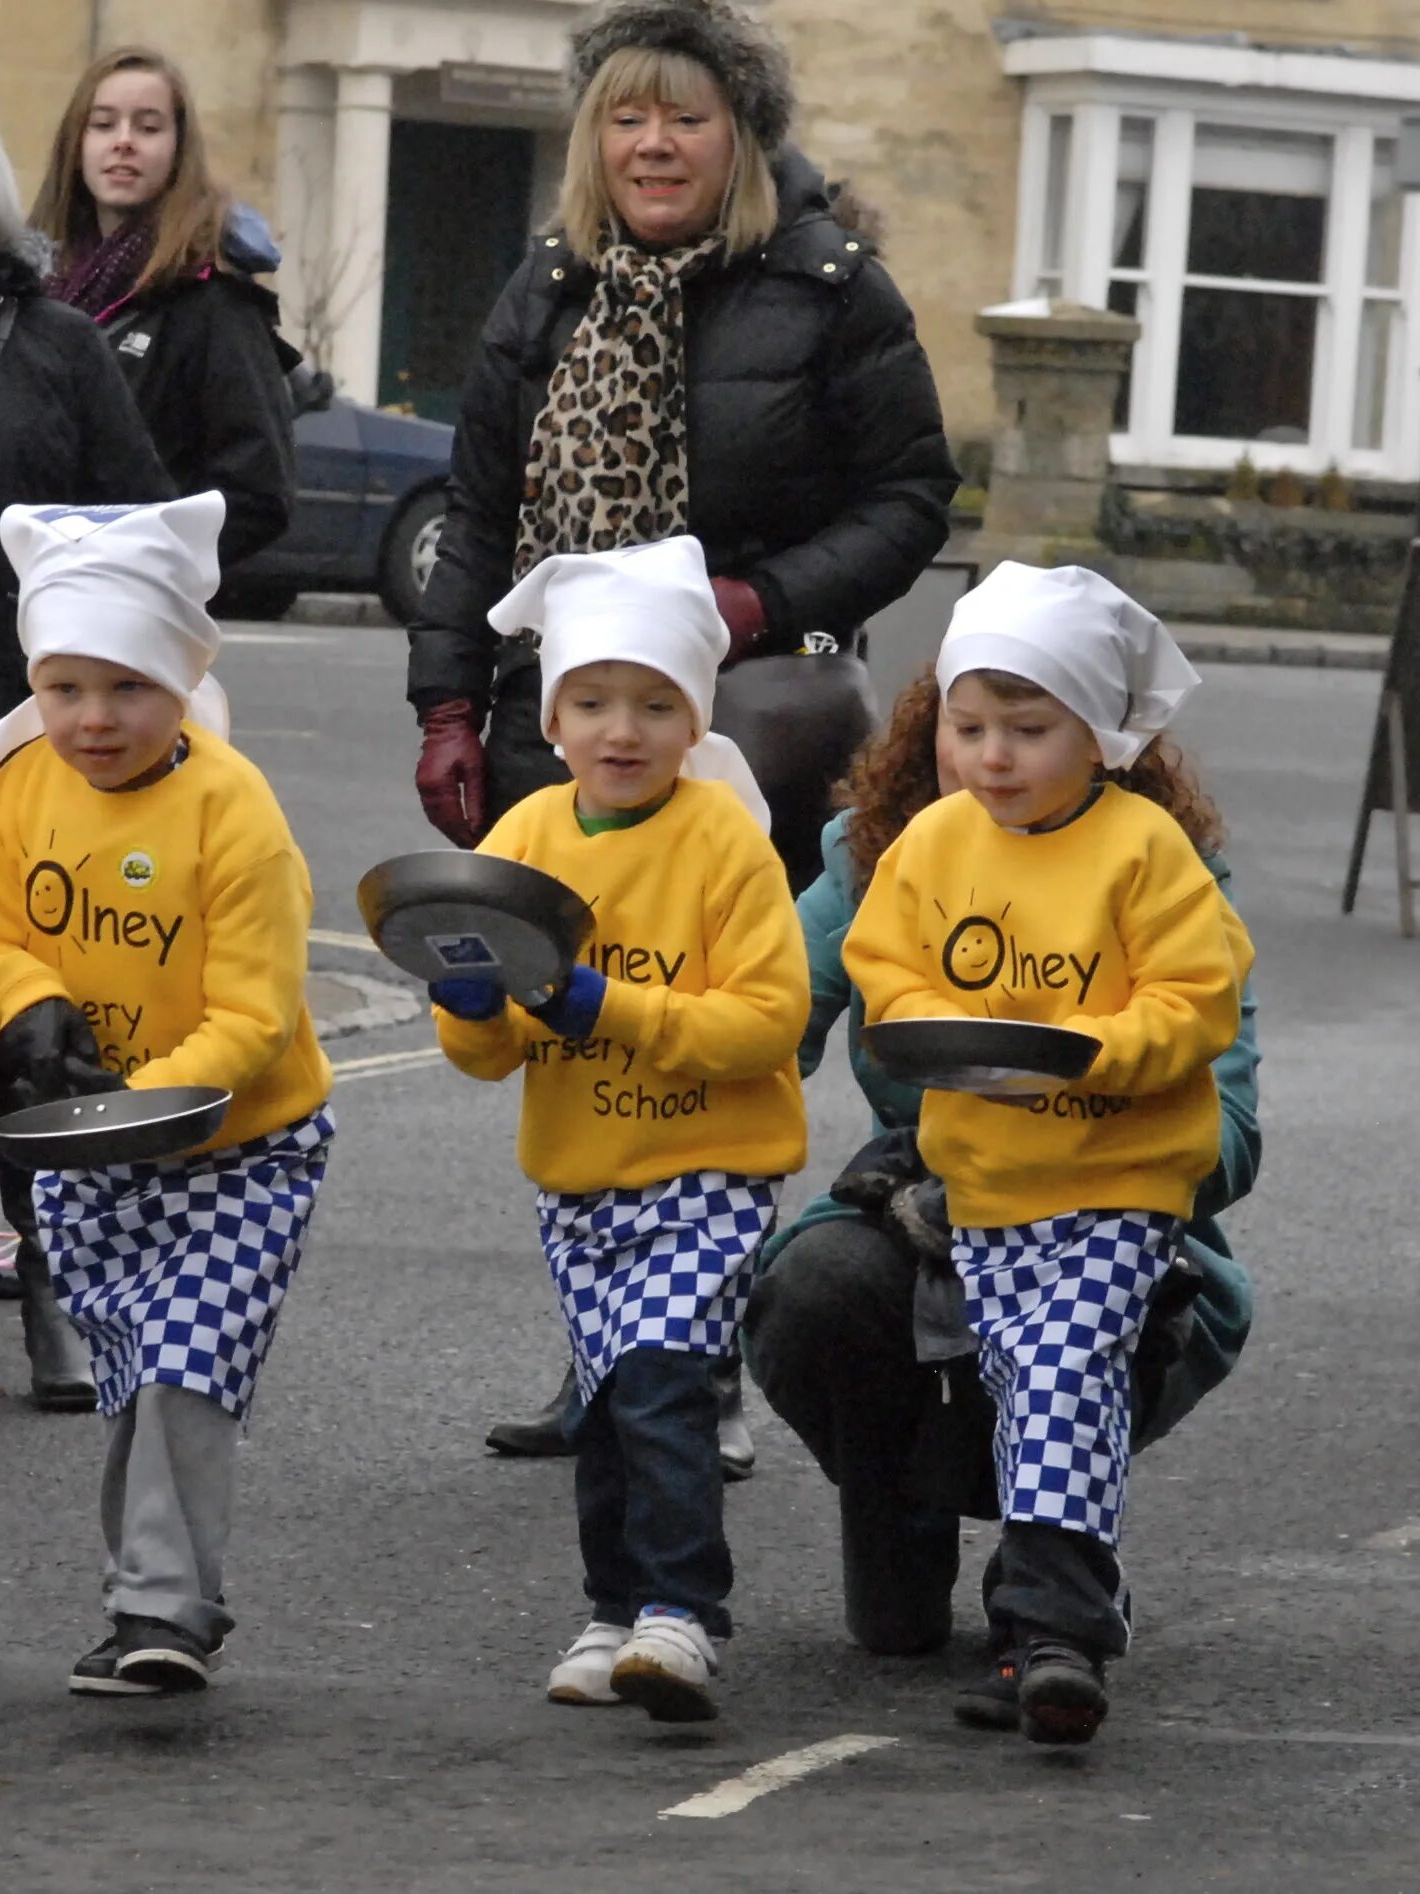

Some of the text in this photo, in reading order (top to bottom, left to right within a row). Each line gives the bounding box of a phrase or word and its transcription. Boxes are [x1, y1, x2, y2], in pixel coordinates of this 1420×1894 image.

[26, 860, 184, 966] Olney
[589, 943, 686, 986] lney
[942, 915, 1101, 1005] Olney
[525, 1036, 635, 1075] ursery
[593, 1080, 708, 1120] School
